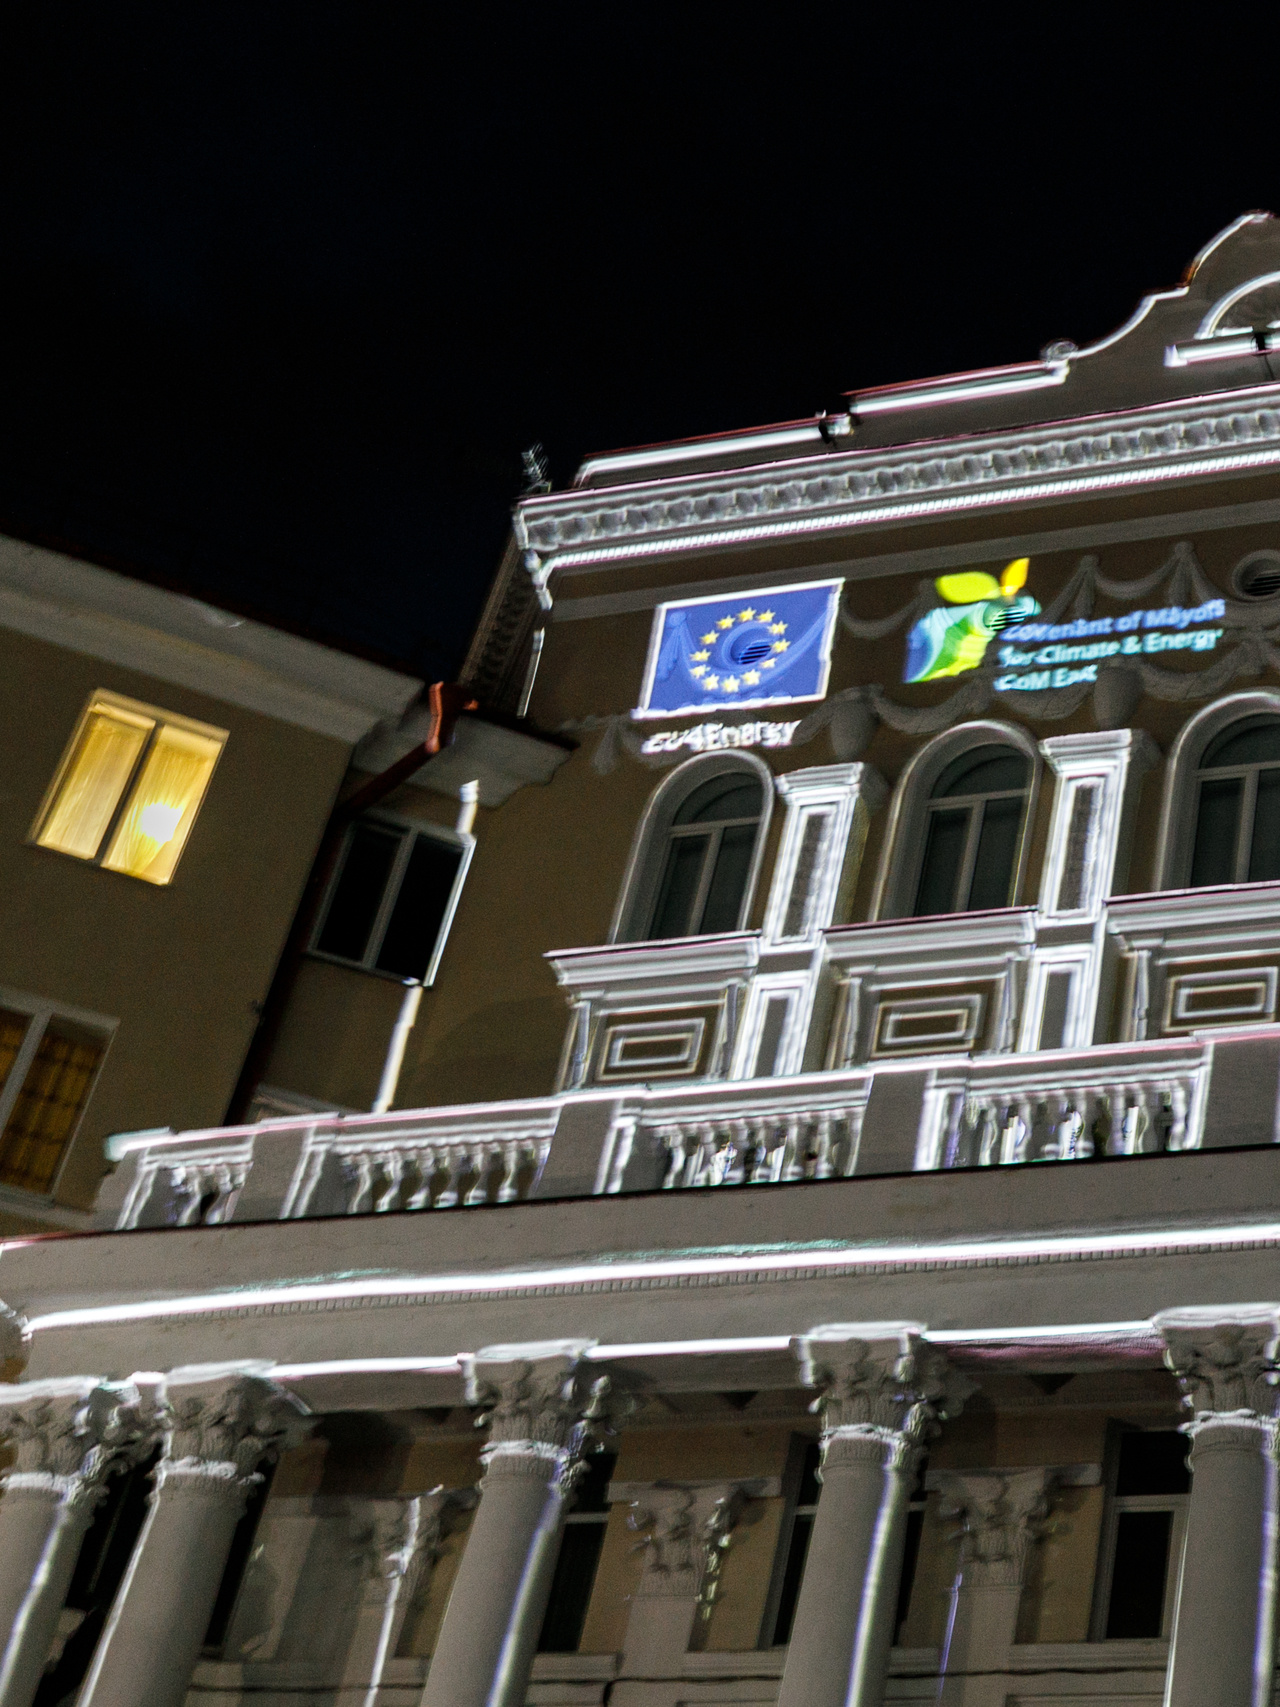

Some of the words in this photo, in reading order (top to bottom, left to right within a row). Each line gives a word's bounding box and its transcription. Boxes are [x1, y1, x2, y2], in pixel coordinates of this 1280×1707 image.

[1113, 610, 1143, 631] of
[1142, 598, 1226, 629] Mayors
[1034, 641, 1120, 664] Climate
[1121, 635, 1142, 654] &
[1142, 628, 1224, 651] Energy
